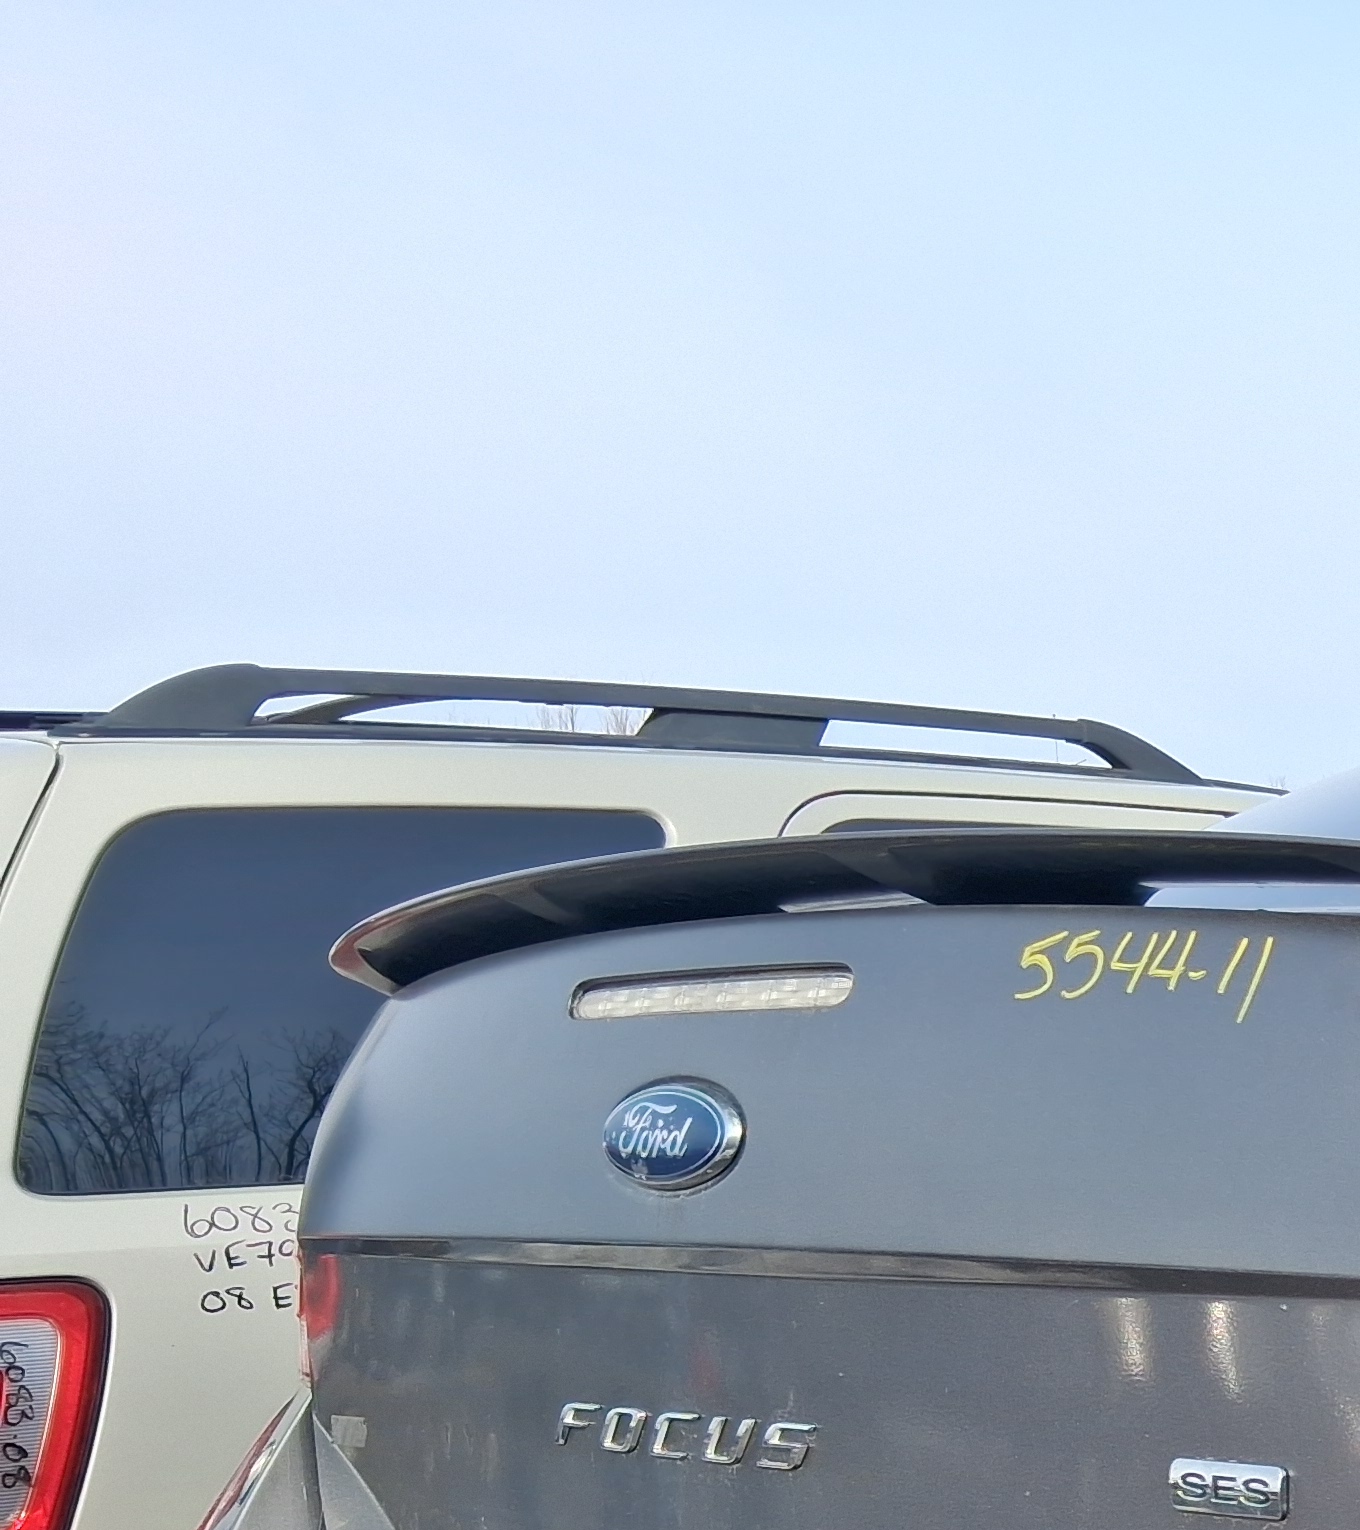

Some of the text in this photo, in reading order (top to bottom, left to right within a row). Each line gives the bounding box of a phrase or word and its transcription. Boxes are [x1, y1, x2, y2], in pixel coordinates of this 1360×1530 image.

[617, 1101, 693, 1159] Ford
[201, 1282, 299, 1313] 08 E
[555, 1402, 817, 1470] FOCUS
[1177, 1471, 1272, 1508] SES
